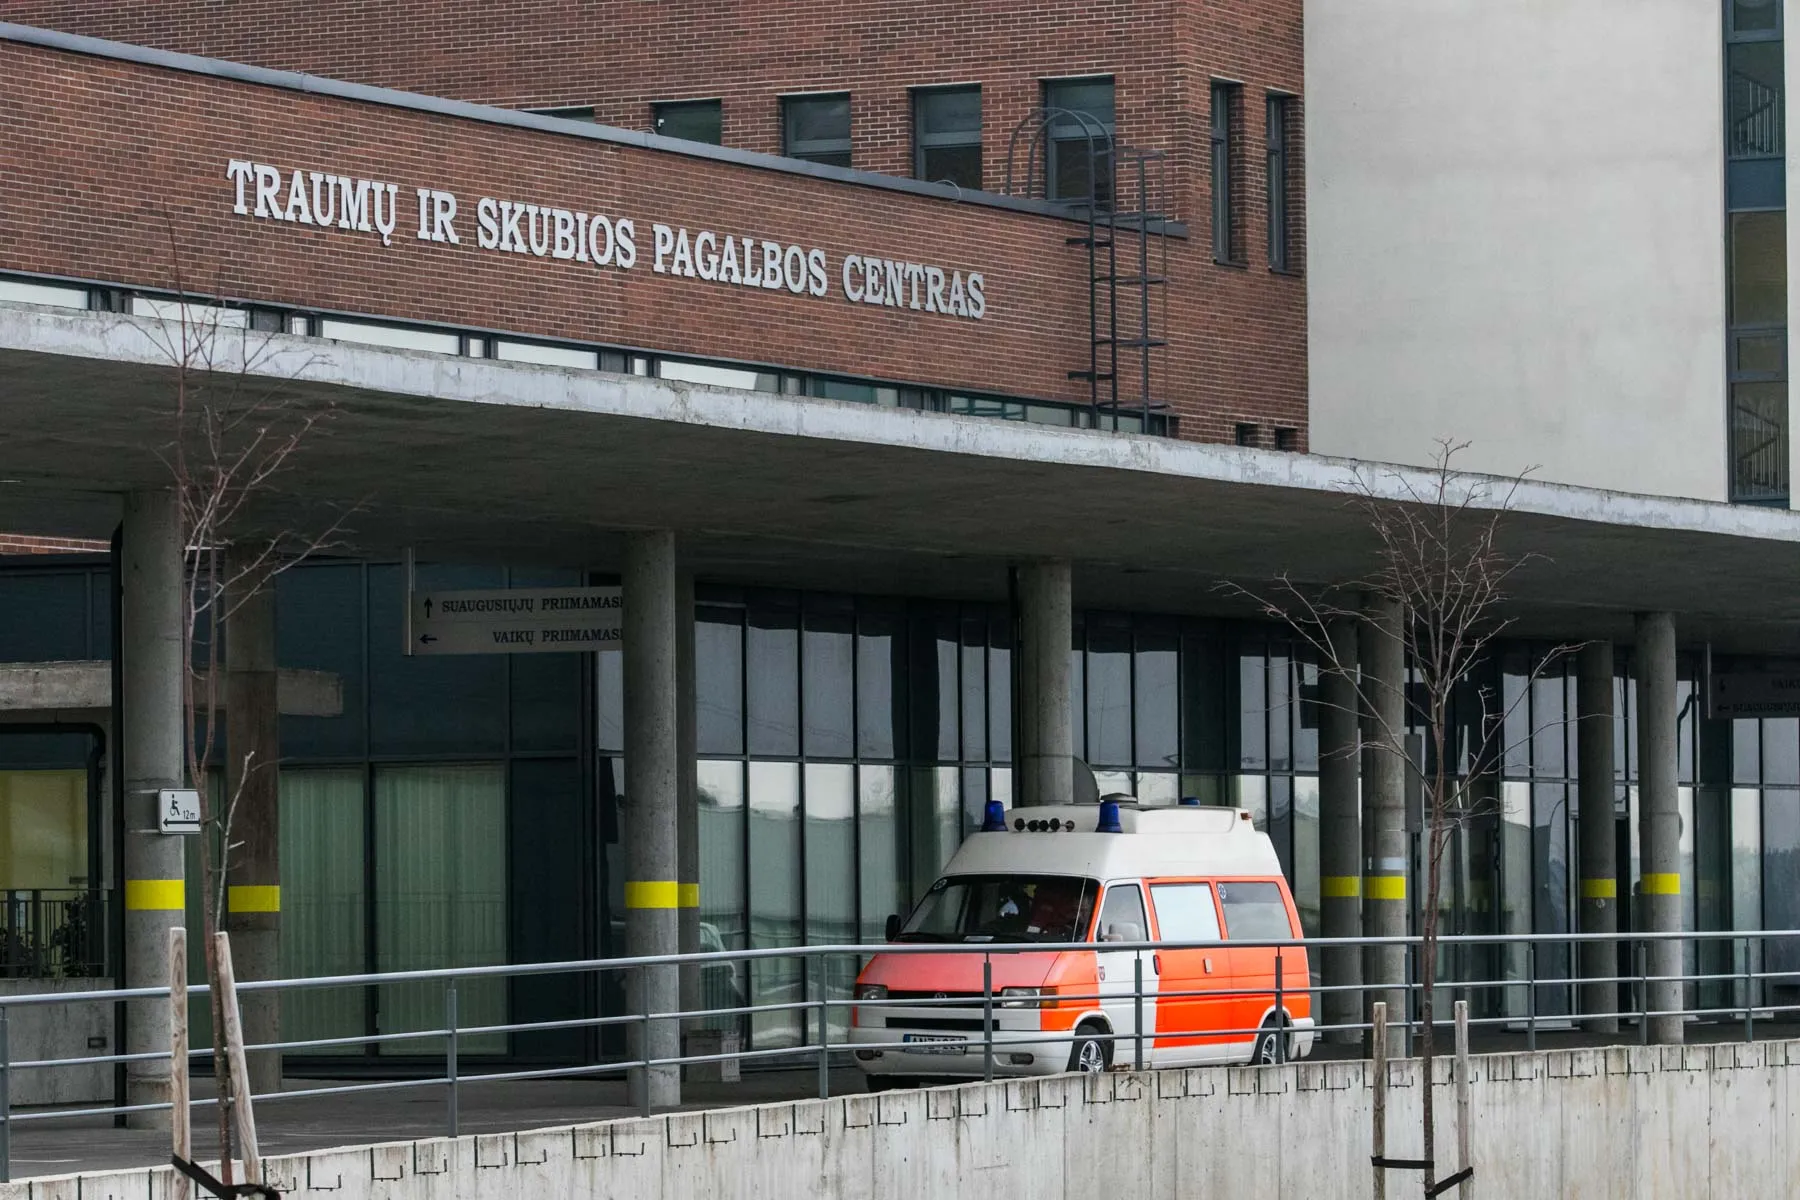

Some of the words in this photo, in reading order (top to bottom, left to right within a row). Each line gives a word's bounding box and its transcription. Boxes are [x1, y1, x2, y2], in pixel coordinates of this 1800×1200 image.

[226, 158, 399, 247] TRAUMŲ
[416, 188, 460, 245] IR
[476, 197, 637, 270] SKUBIOS
[652, 223, 829, 297] PAGALBOS
[842, 254, 986, 320] CENTRAS
[493, 630, 536, 645] VAIKŲ
